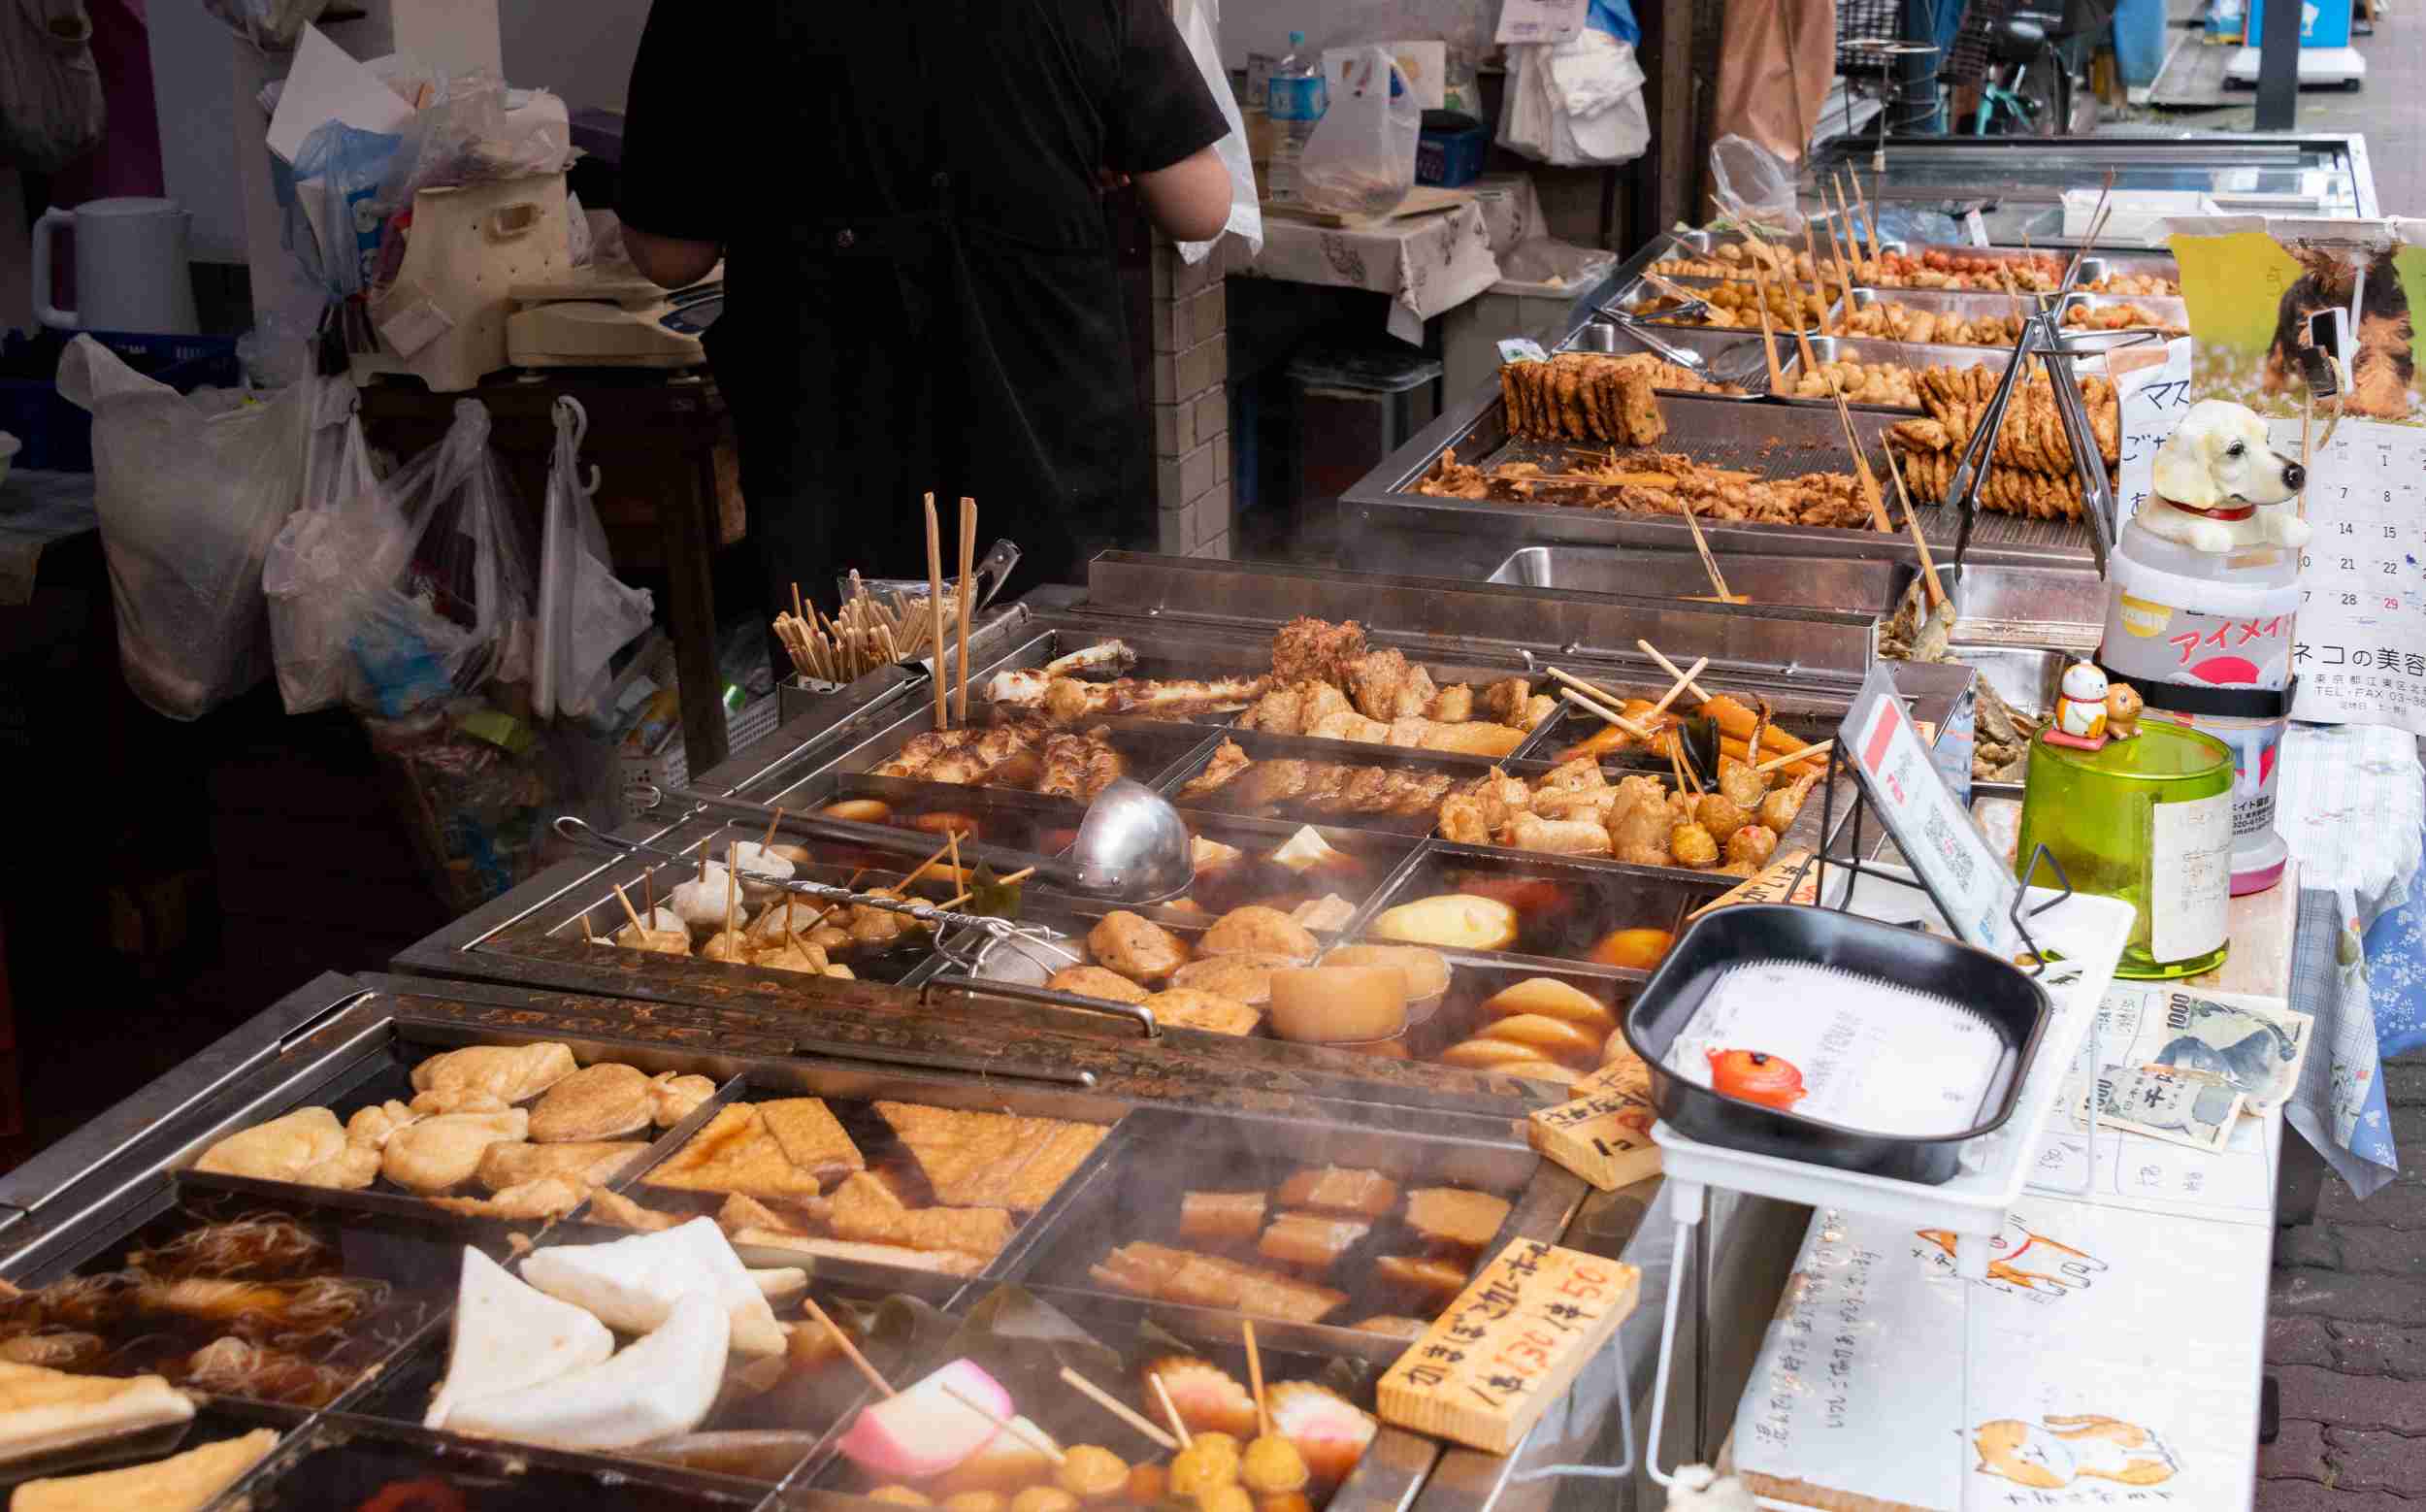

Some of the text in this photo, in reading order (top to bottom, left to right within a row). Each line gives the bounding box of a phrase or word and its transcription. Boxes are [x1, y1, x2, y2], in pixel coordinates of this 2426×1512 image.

[2382, 455, 2388, 467] 1
[2340, 487, 2348, 499] 7
[2383, 490, 2391, 502] 8
[2339, 522, 2397, 539] 14 15
[2341, 557, 2355, 570] 21
[2383, 561, 2398, 575] 22
[2342, 593, 2357, 606] 28
[2383, 597, 2399, 609] 29
[2293, 641, 2426, 676] ネコの美容
[2167, 993, 2190, 1030] 1000
